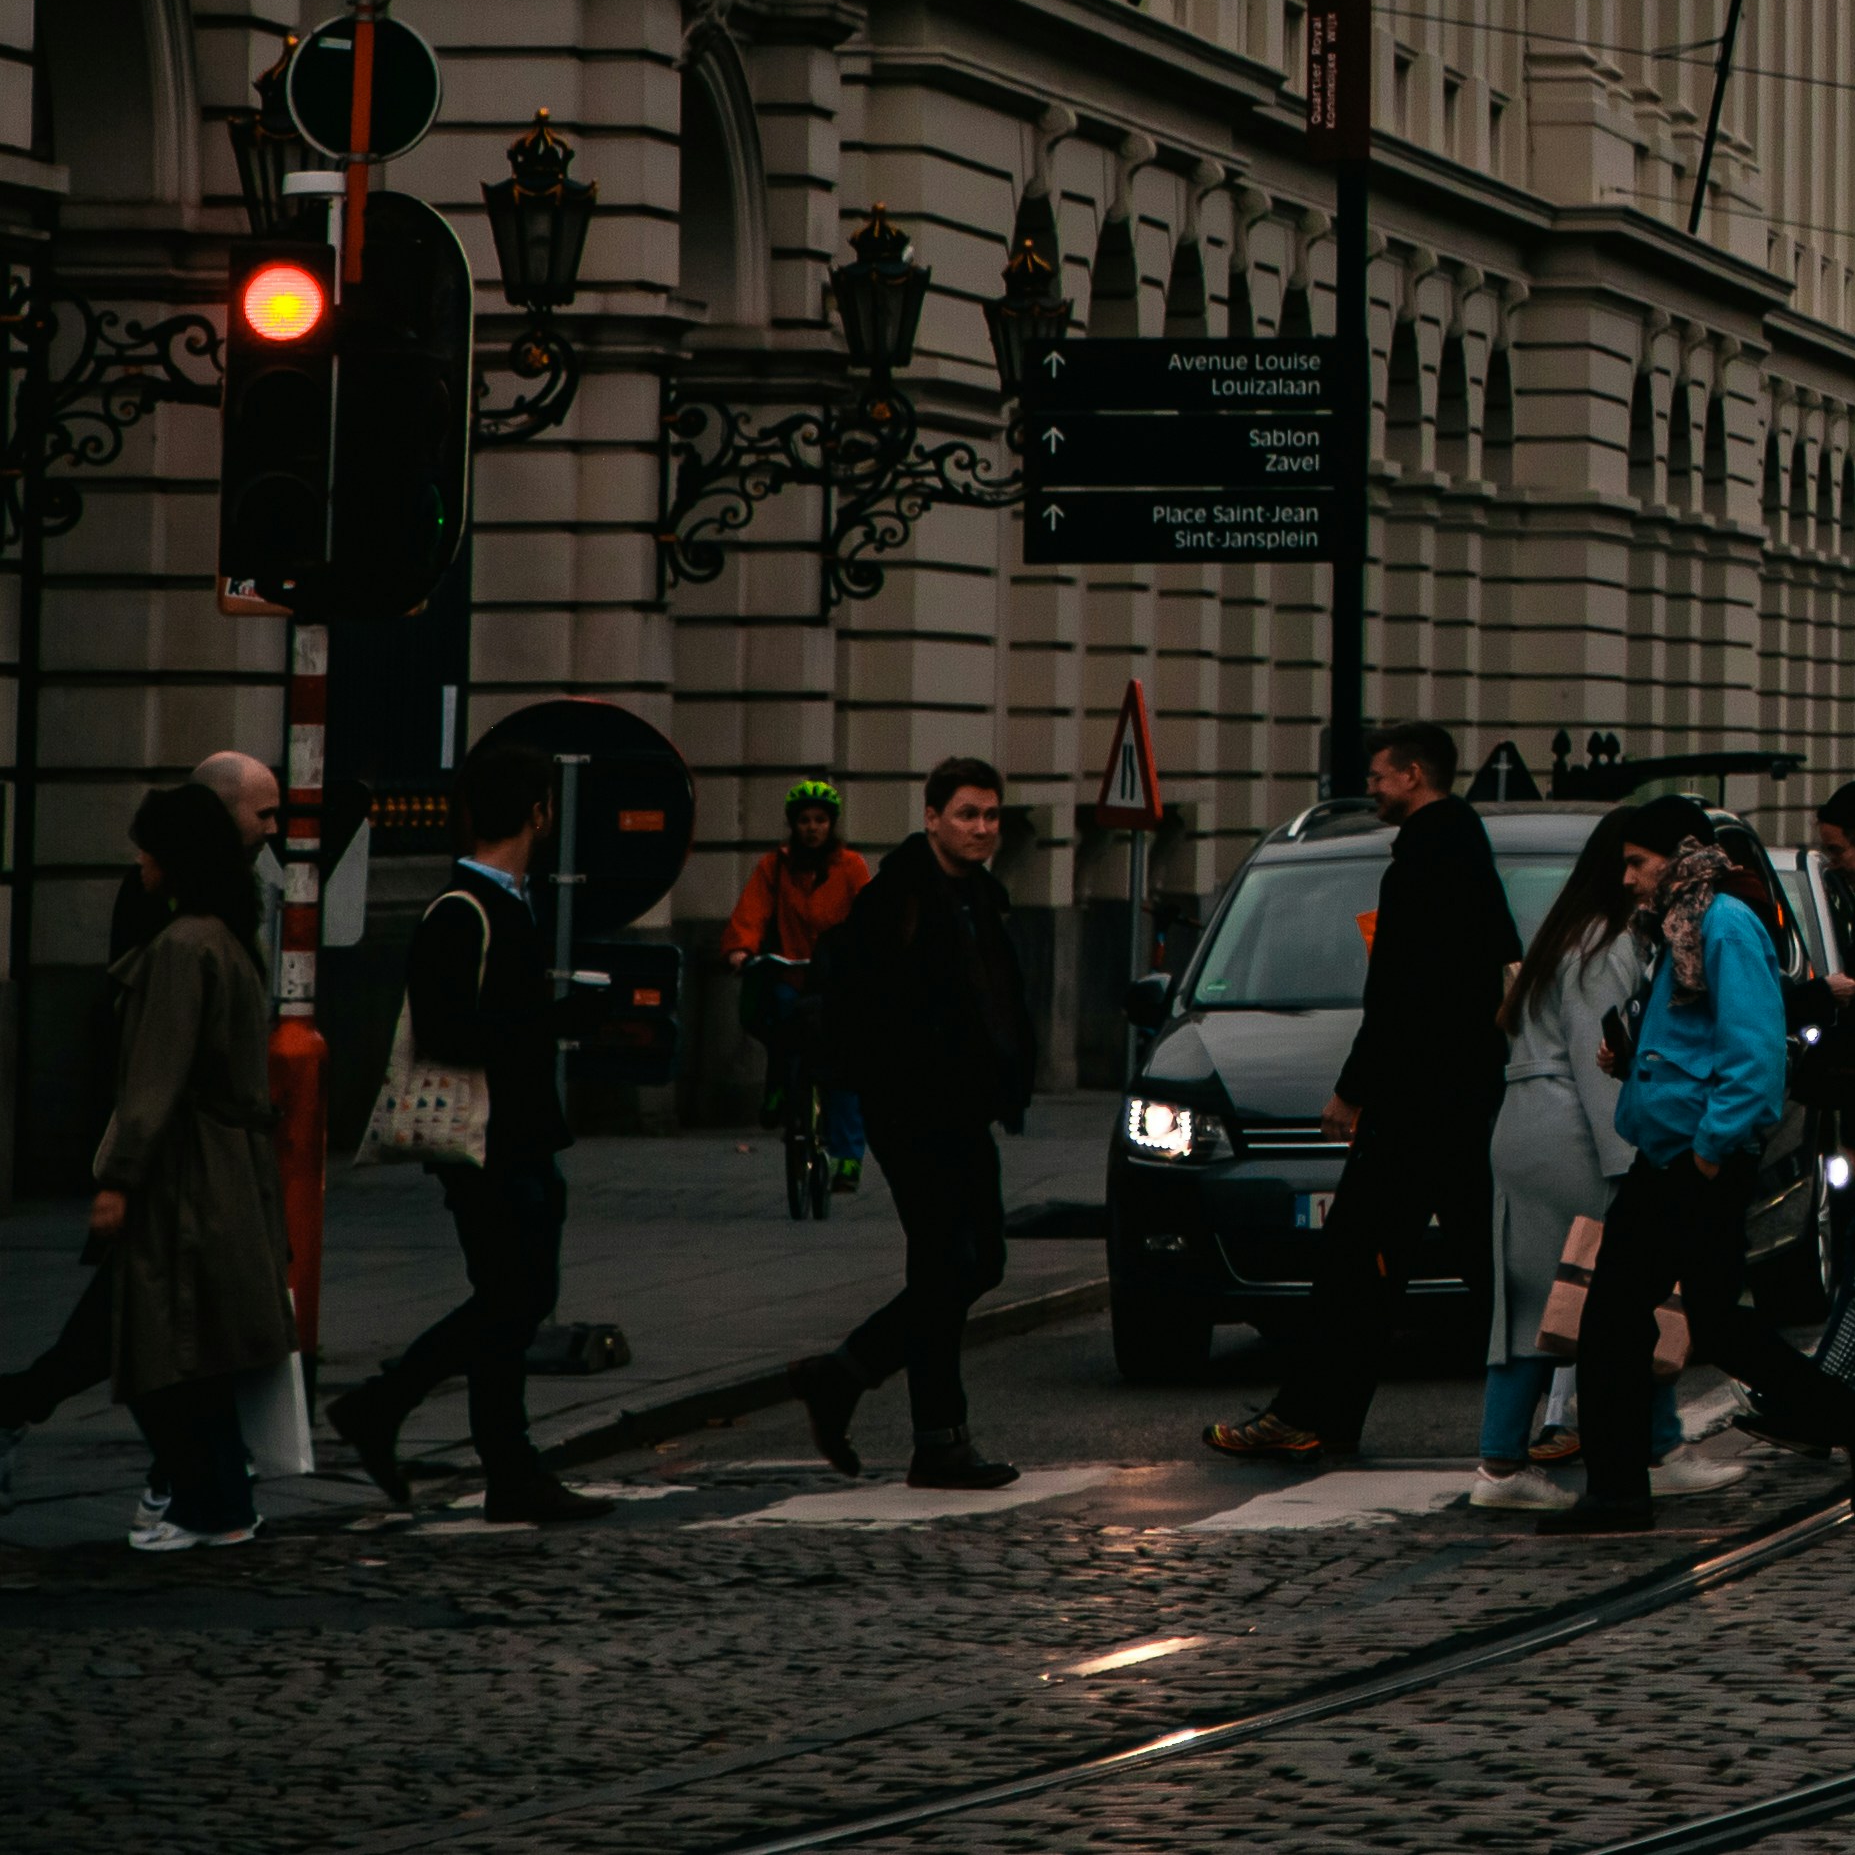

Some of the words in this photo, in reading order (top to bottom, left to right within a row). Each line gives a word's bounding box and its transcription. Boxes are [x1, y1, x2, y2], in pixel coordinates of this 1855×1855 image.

[1168, 352, 1248, 371] Avenue
[1254, 352, 1321, 371] Louise
[1211, 377, 1321, 396] Louizalaan
[1249, 429, 1320, 448] Sablon
[1265, 453, 1320, 472] Zavel
[1152, 505, 1207, 524] Place
[1212, 505, 1319, 524] Saint-Jean
[1174, 529, 1319, 551] Sint-Jansplein
